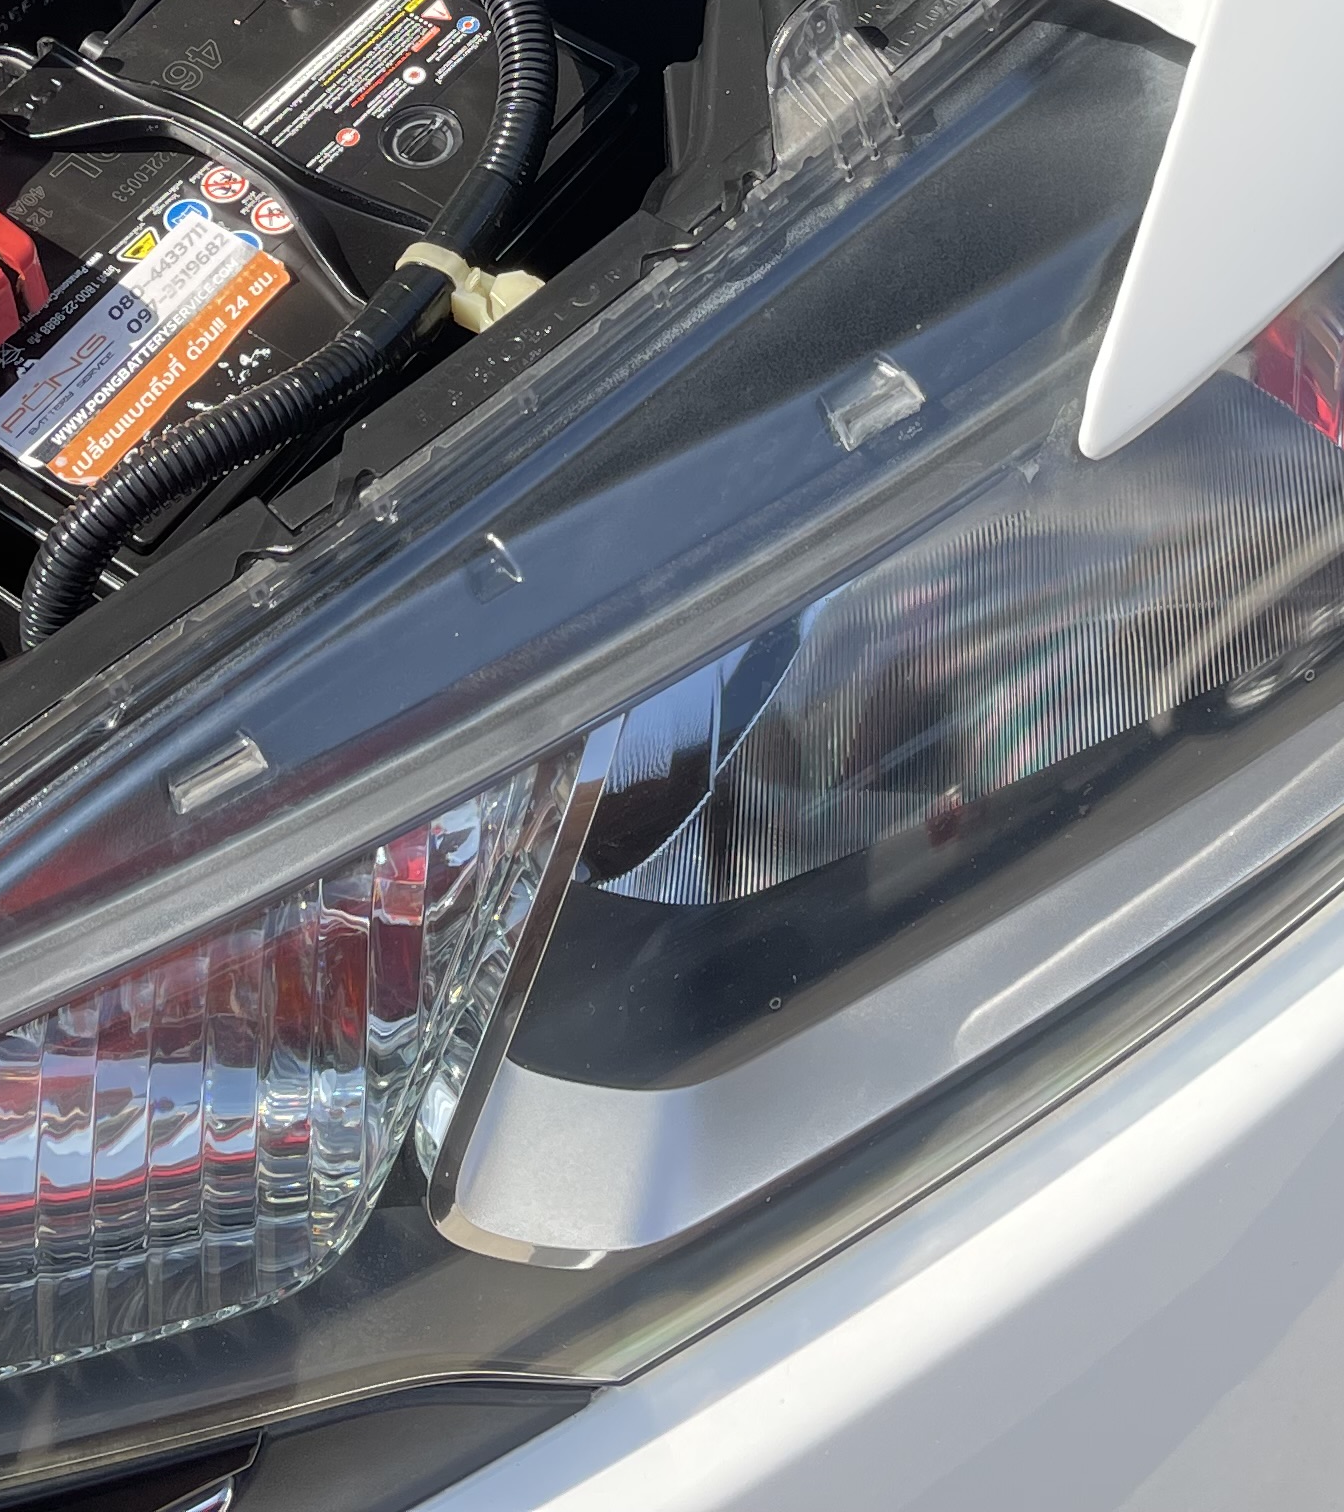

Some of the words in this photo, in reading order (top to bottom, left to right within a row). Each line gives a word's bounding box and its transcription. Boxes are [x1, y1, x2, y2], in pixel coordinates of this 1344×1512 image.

[108, 223, 208, 321] 080-4433711
[126, 233, 229, 334] 097-3519682
[225, 295, 249, 320] 24
[51, 259, 240, 447] WWW.PONGBATTERYSERVICE.COM
[76, 351, 115, 388] SERVICE
